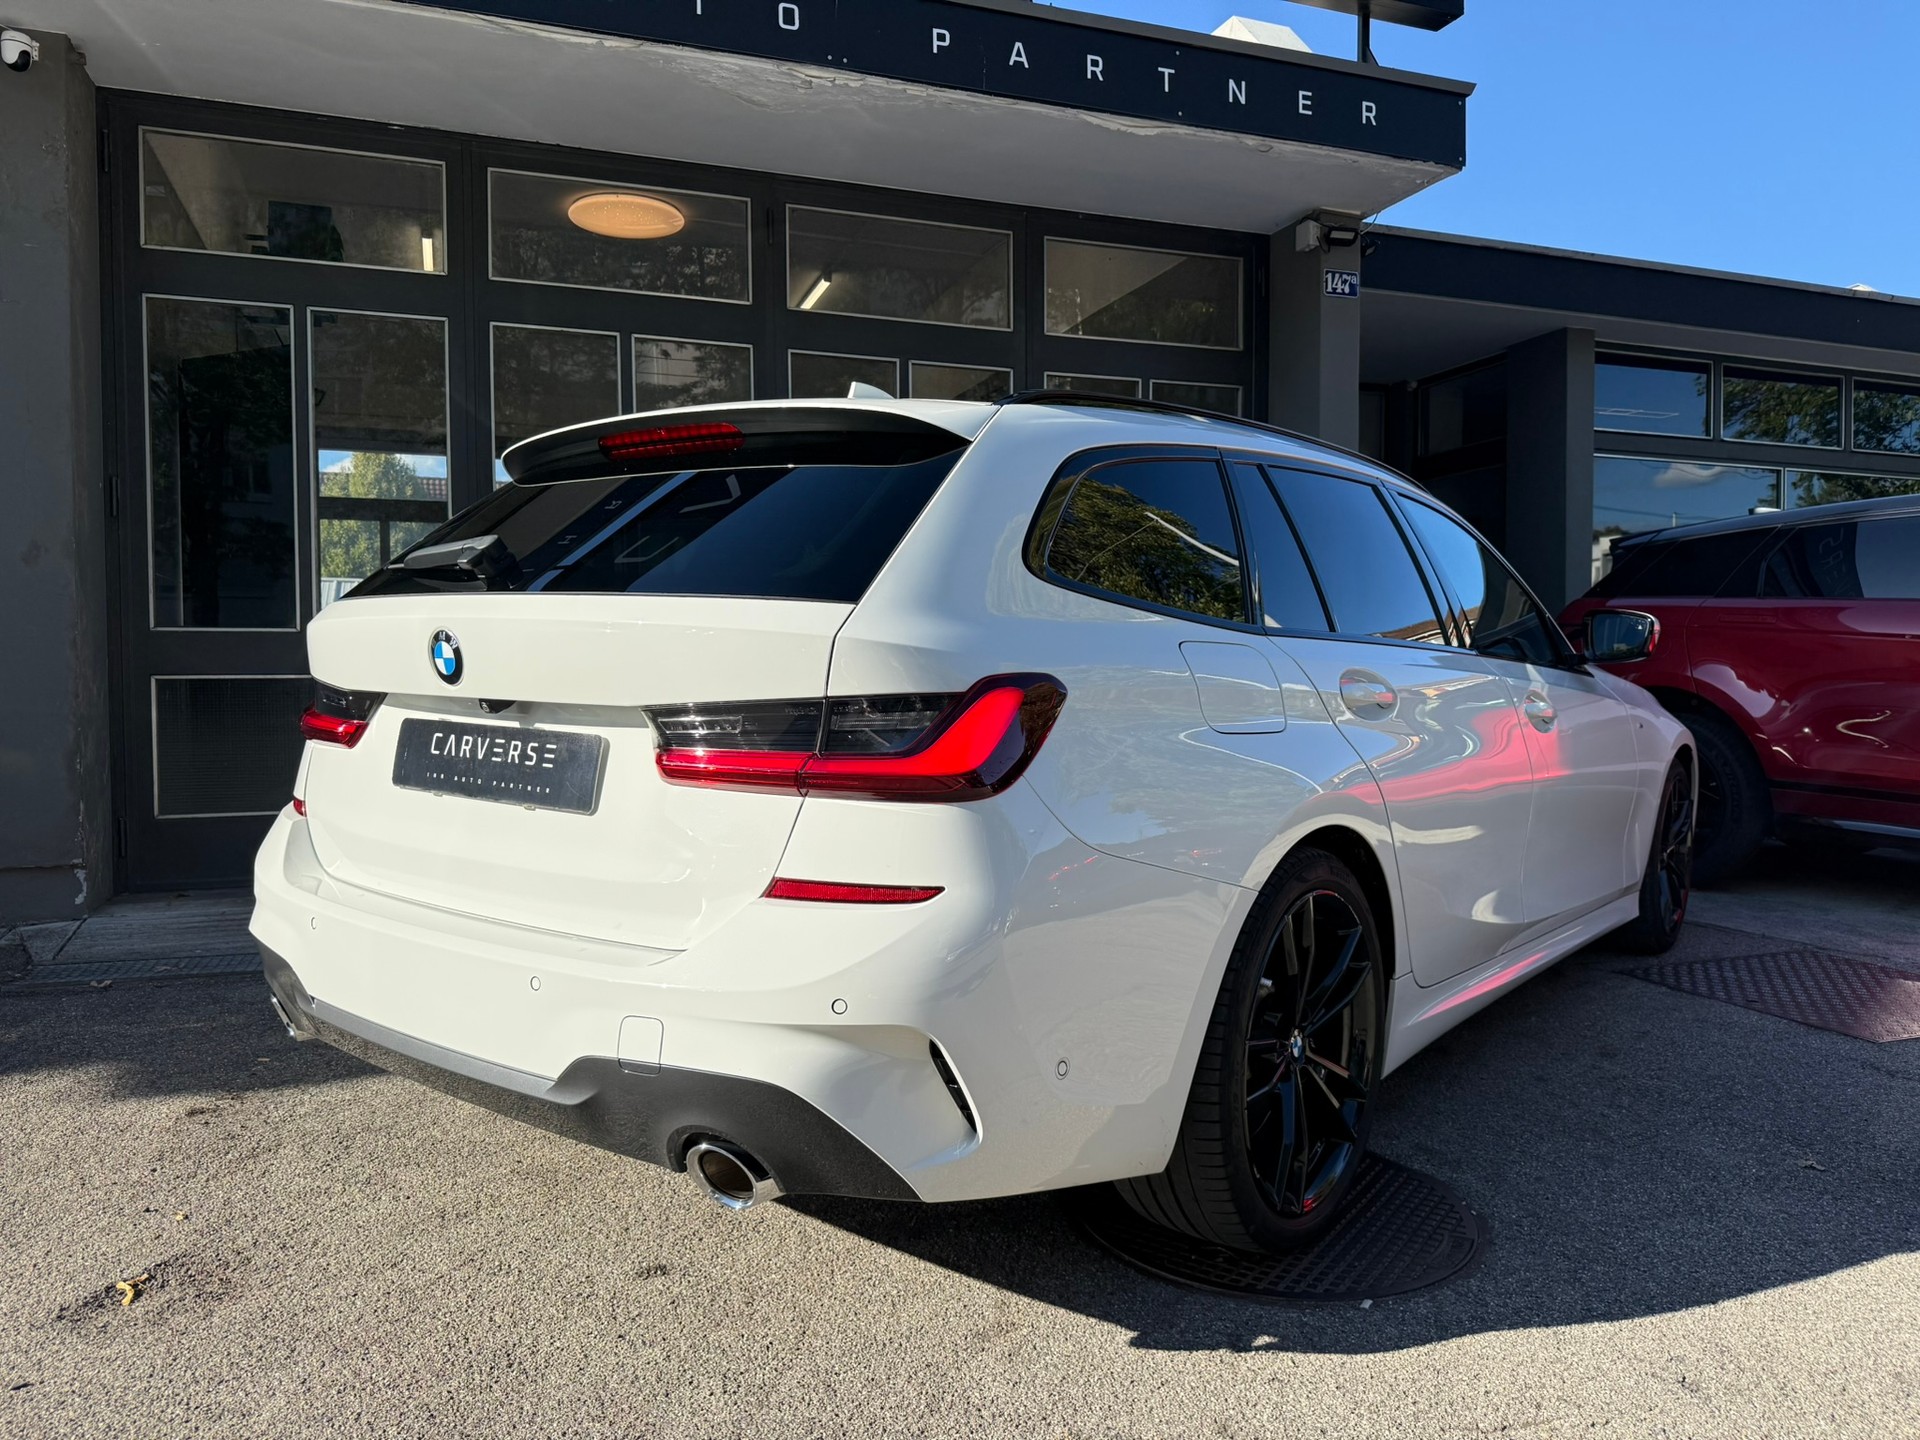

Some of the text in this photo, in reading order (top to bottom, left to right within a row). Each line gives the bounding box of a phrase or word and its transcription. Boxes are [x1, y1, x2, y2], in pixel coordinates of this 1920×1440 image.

[932, 28, 1377, 126] PARTNER
[1325, 272, 1357, 294] 147a
[430, 732, 557, 768] CARVERSE
[454, 775, 482, 785] AUTO
[492, 780, 550, 794] PARTNER
